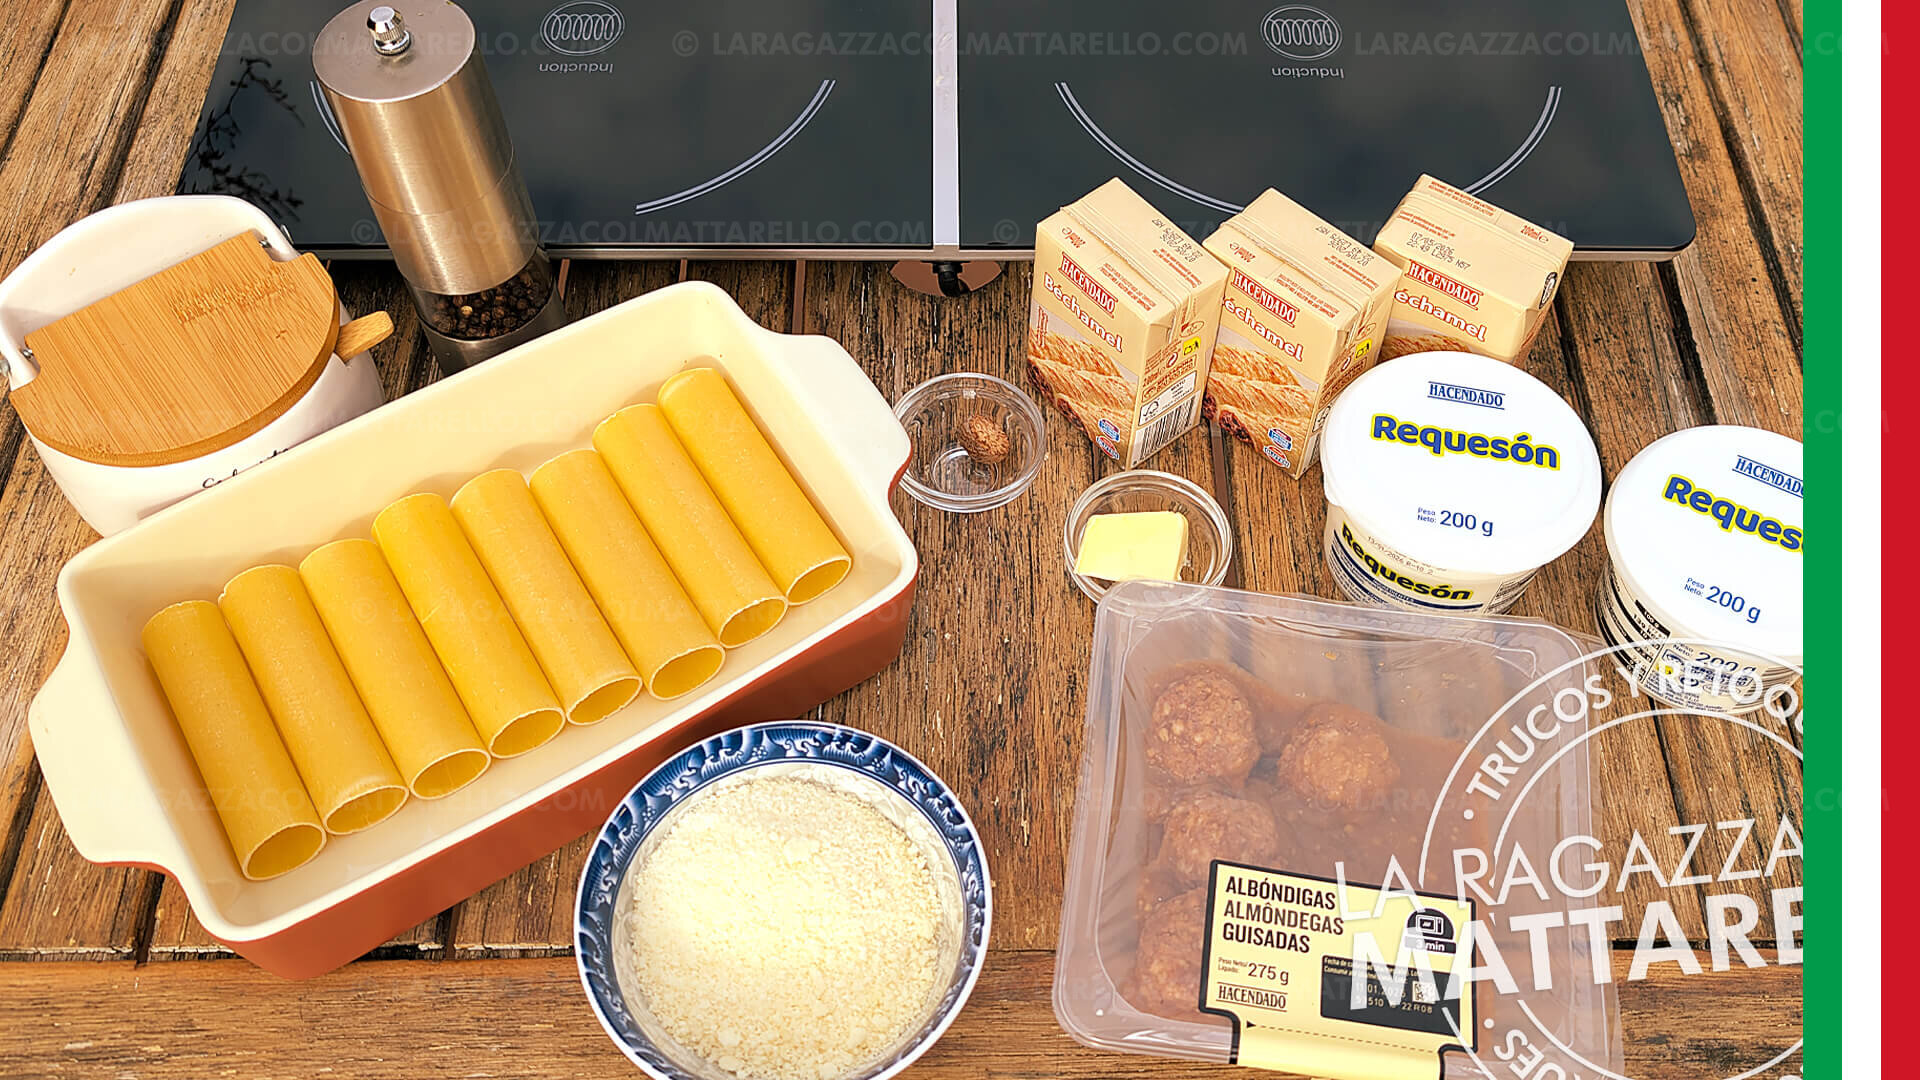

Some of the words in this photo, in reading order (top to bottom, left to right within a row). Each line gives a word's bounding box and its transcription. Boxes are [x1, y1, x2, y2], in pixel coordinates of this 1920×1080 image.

[539, 62, 614, 74] Induction
[1271, 67, 1344, 78] Induction
[1061, 255, 1116, 314] HACENDADO
[1233, 270, 1297, 325] HACENDADO
[1408, 261, 1480, 307] HACENDADO
[1044, 273, 1123, 352] Béchamel
[1224, 297, 1303, 362] échamel
[1393, 288, 1487, 342] échamel
[1429, 384, 1503, 408] HACENDADO
[1372, 414, 1559, 469] Requesón
[1735, 457, 1803, 496] HACENDAD
[1417, 507, 1436, 516] Peso
[1440, 510, 1477, 530] 200
[1481, 520, 1494, 536] g
[1664, 476, 1803, 550] Reques
[1341, 521, 1473, 601] Requesón
[1684, 582, 1704, 598] Neto:
[1687, 576, 1705, 590] Peso
[1706, 585, 1746, 613] 200
[1746, 606, 1761, 623] g
[1225, 875, 1336, 911] ALBÓNDIGAS
[1223, 900, 1345, 936] ALMÔNDEGAS
[1222, 922, 1311, 953] GUISADAS
[1425, 941, 1446, 952] min
[1247, 962, 1277, 980] 275
[1280, 970, 1289, 986] g
[1218, 984, 1287, 1009] HACENDADO
